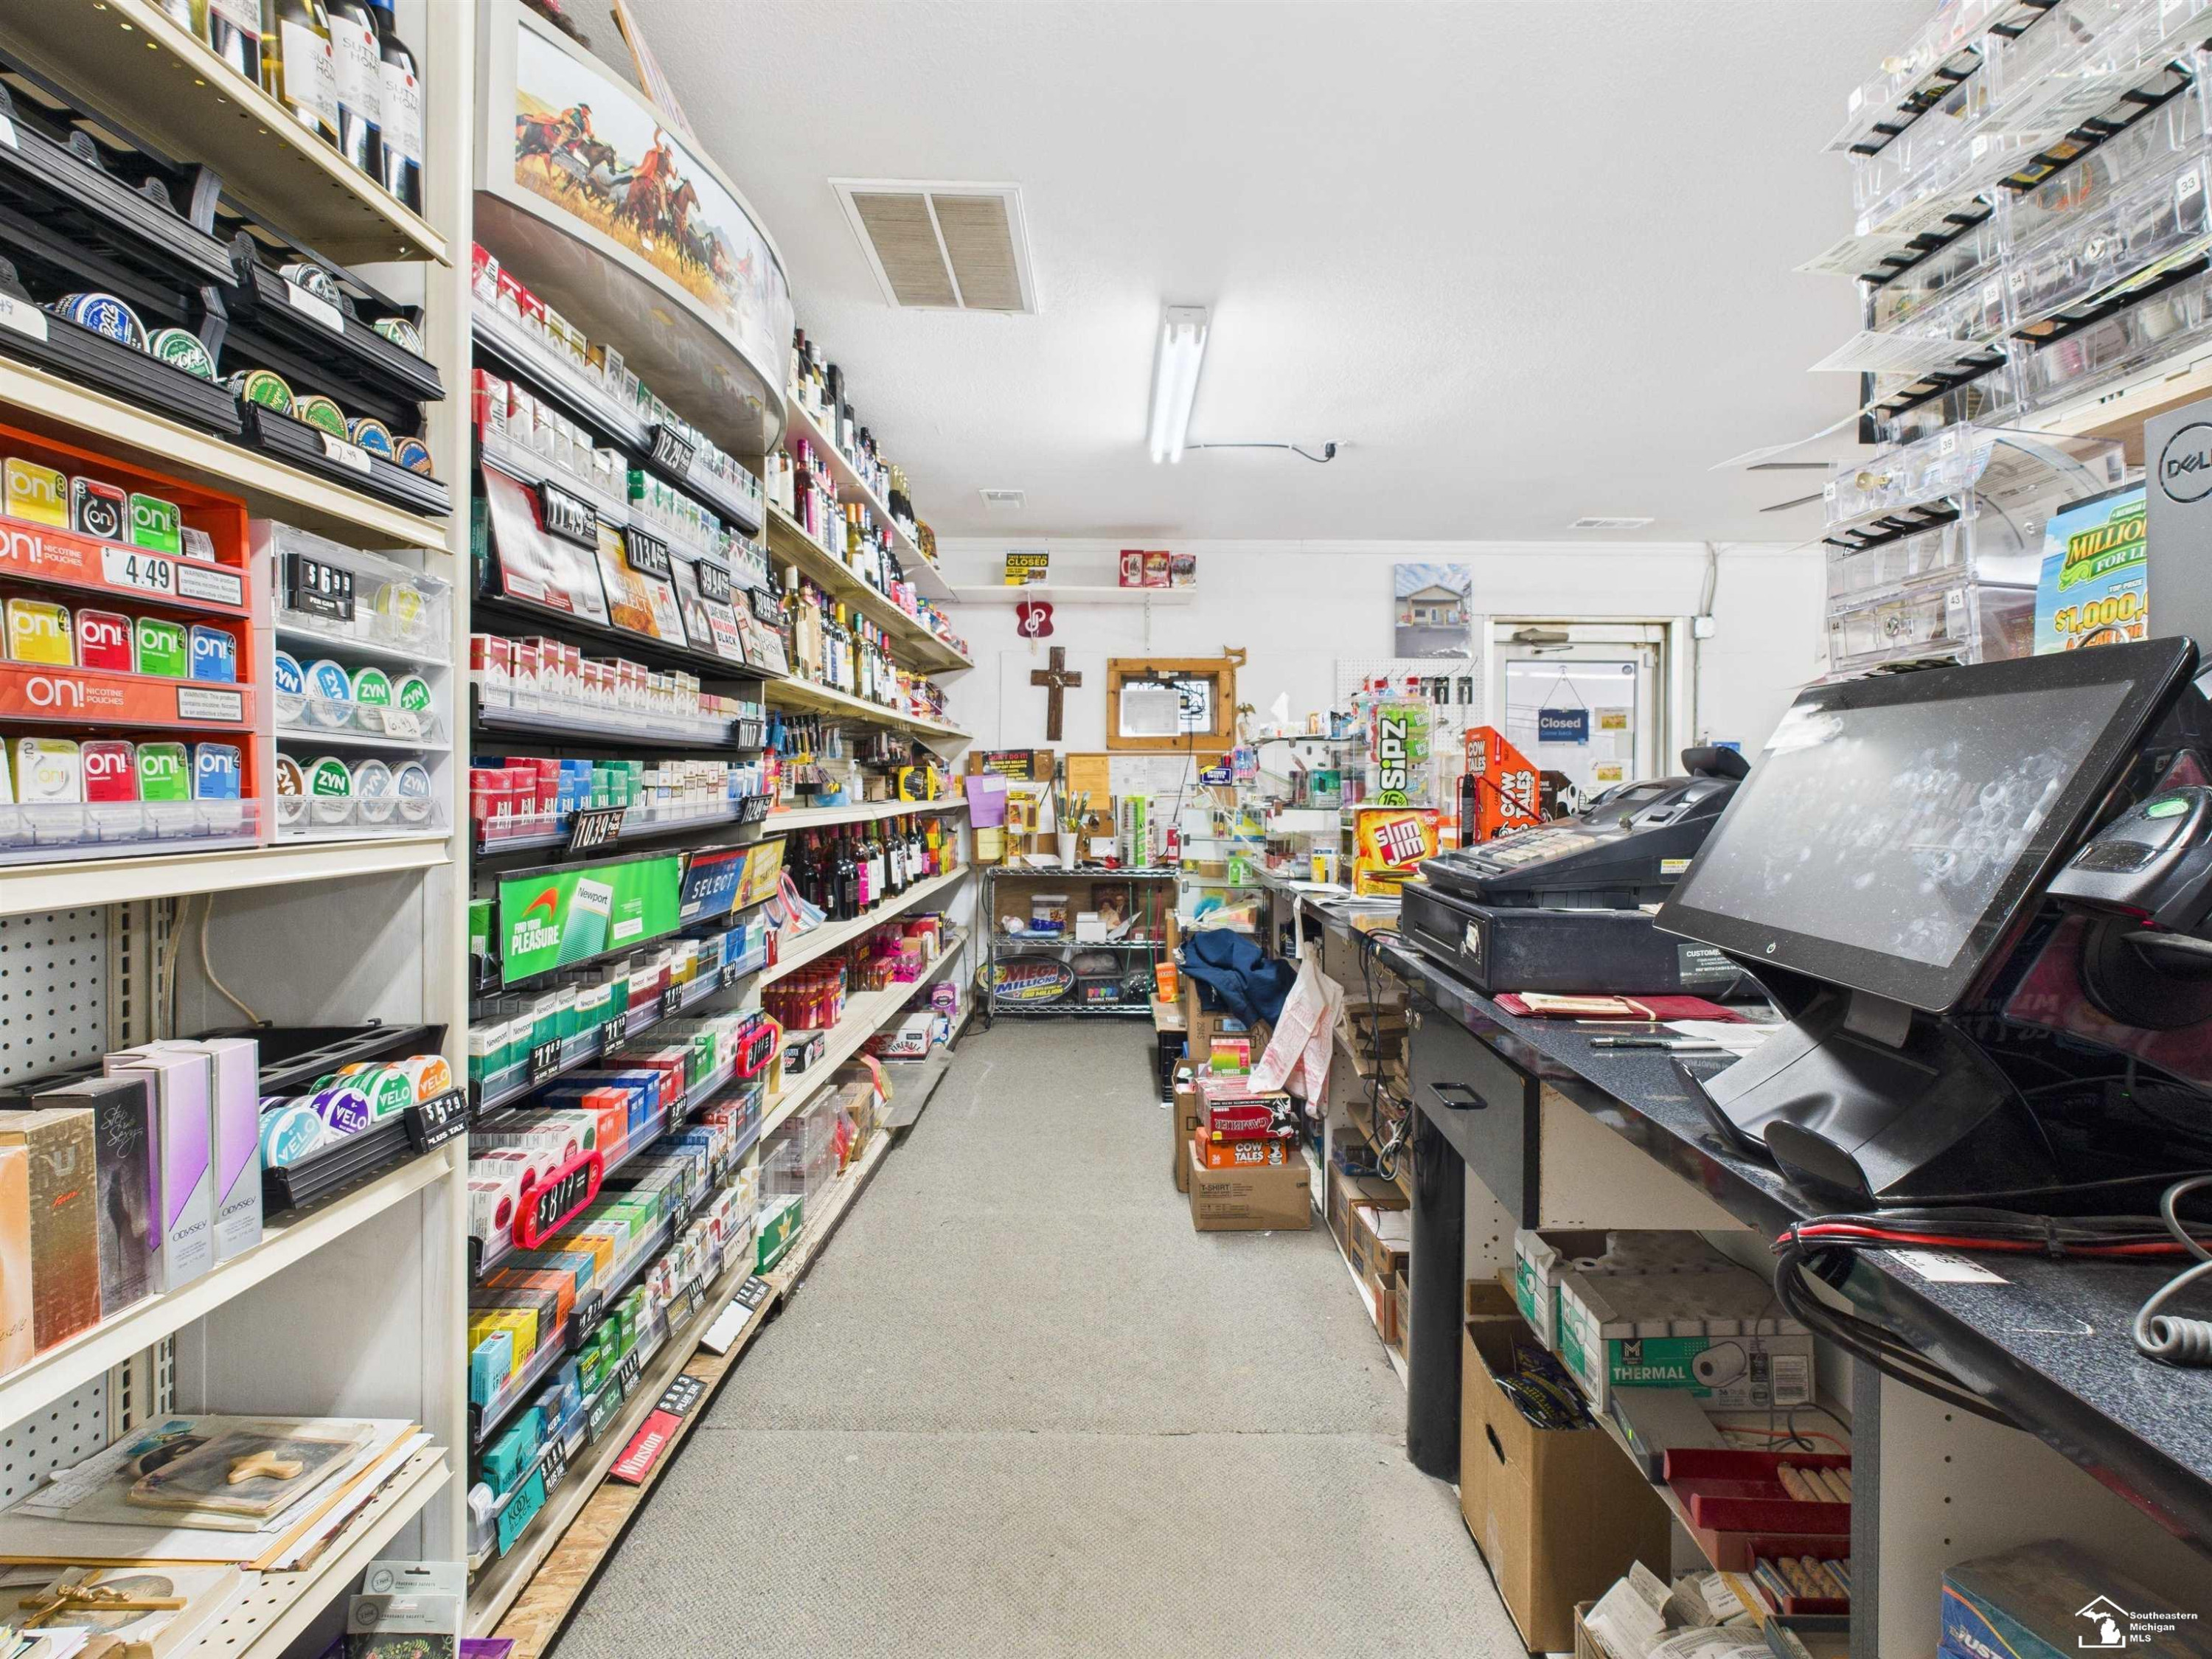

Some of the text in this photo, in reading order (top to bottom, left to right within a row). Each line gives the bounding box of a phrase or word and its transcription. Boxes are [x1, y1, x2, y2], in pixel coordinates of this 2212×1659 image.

[2181, 178, 2196, 193] 33
[2011, 274, 2023, 286] 34
[1942, 438, 1952, 450] 39
[2166, 454, 2212, 481] DEL
[11, 472, 55, 504] on!
[133, 505, 170, 532] on!
[44, 544, 83, 559] NICOTINE
[44, 552, 83, 567] POUCHES
[125, 554, 170, 589] 4.49
[1007, 558, 1047, 566] CLOSED
[2096, 552, 2126, 573] FOR
[2108, 577, 2144, 593] TOP PRIZE
[1950, 594, 1961, 605] 43
[13, 611, 58, 636] on!
[81, 621, 122, 646] on!
[140, 628, 178, 653] on!
[194, 635, 226, 659] on!
[26, 676, 85, 708] on!
[86, 687, 124, 698] NICOTINE
[361, 683, 386, 698] ZYN
[402, 686, 424, 711] ZYN
[86, 695, 125, 706] POUCHES
[1540, 717, 1582, 728] Closed
[1467, 740, 1486, 757] COW
[85, 753, 127, 773] on!
[142, 755, 178, 776] on!
[199, 753, 233, 773] on!
[1467, 757, 1486, 772] TALES
[318, 771, 346, 790] ZYN
[403, 774, 427, 793] ZYN
[1500, 771, 1517, 818] COW
[1516, 771, 1531, 819] TALES
[691, 872, 734, 899] SELECT
[577, 886, 608, 905] Newport
[515, 920, 527, 933] FIND
[511, 924, 560, 956] PLEASURE
[1004, 964, 1060, 983] MEGA
[995, 975, 1057, 994] MILLIONS
[1035, 987, 1064, 997] MILLION
[536, 1001, 555, 1015] Newport
[512, 1022, 532, 1036] Newport
[486, 1030, 507, 1048] Newport
[890, 1040, 922, 1053] FIREBALL
[420, 1068, 448, 1093] VELO
[379, 1086, 410, 1105] VELO
[335, 1104, 367, 1130] VELO
[1214, 1118, 1269, 1130] GAMBLER
[278, 1118, 316, 1161] VELO
[426, 1122, 465, 1145] PLUS TAX
[1235, 1143, 1262, 1152] COW
[1235, 1152, 1265, 1161] TALES
[1201, 1183, 1229, 1192] T-SHIRT
[222, 1196, 257, 1217] ODYSSEY
[173, 1220, 207, 1242] ODYSSEY
[1613, 1366, 1686, 1381] THERMAL
[675, 1383, 700, 1411] PLUS TAX
[547, 1413, 562, 1434] KOOL
[617, 1432, 664, 1475] Winston
[507, 1491, 531, 1526] KOOL
